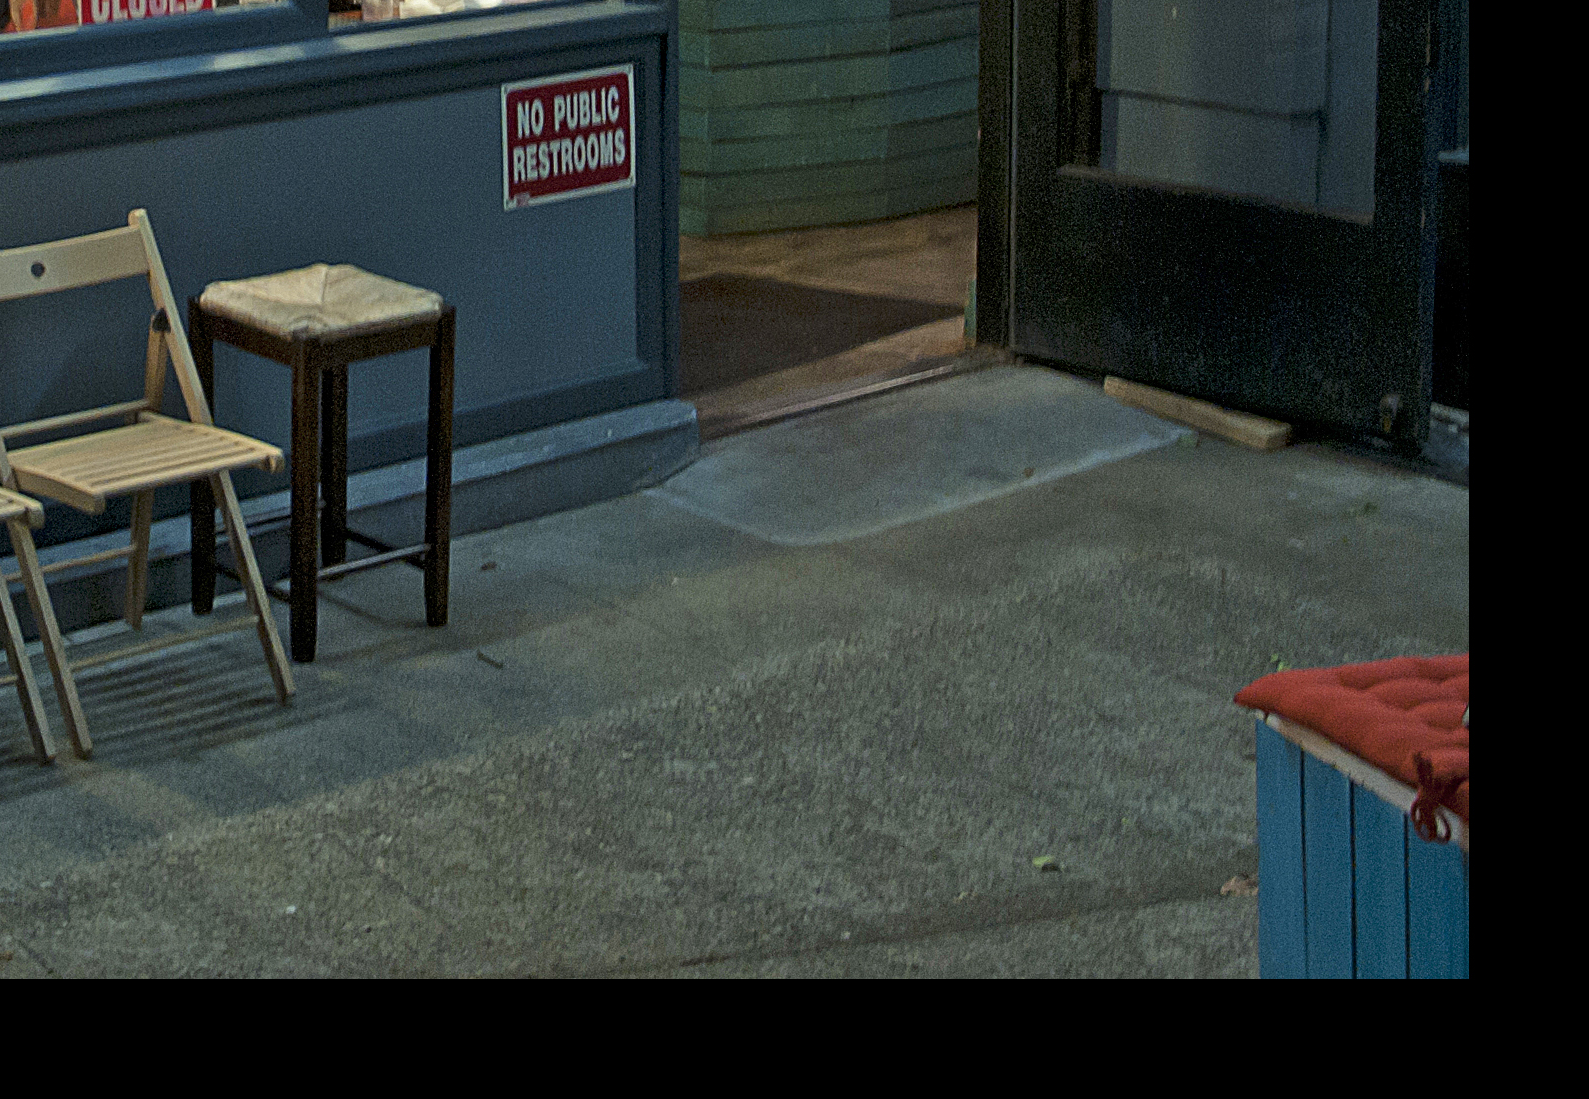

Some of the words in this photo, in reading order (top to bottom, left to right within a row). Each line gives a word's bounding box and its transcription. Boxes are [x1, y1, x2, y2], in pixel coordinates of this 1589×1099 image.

[517, 97, 545, 140] NO
[554, 84, 620, 132] PUBLIC
[513, 126, 626, 184] RESTROOMS
